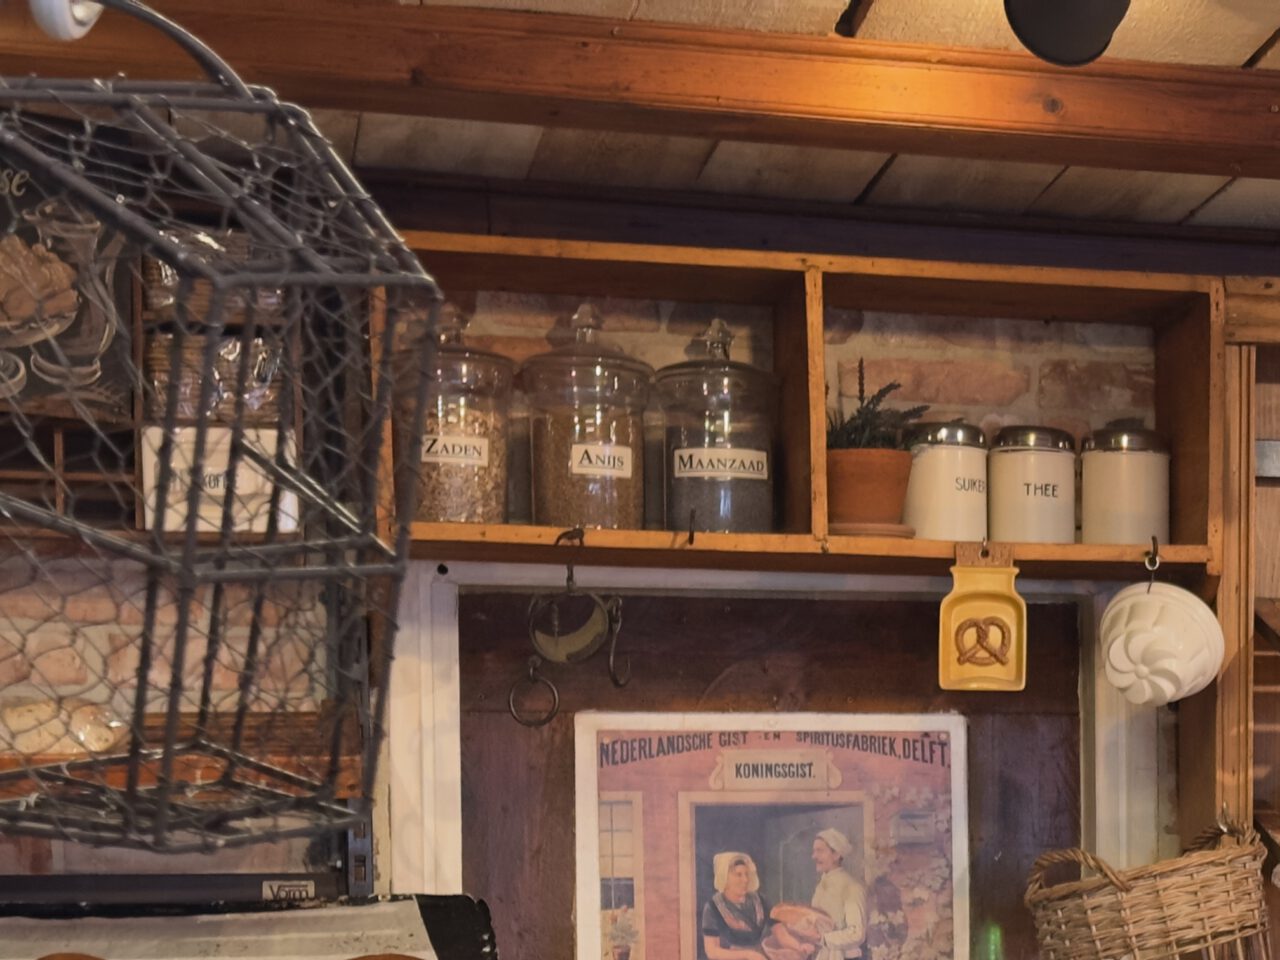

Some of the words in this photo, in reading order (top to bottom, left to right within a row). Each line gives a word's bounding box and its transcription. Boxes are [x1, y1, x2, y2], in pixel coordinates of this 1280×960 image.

[678, 453, 766, 473] MAANZAAD
[1023, 482, 1059, 499] THEE
[600, 732, 713, 768] NEDERLANDSCHE
[718, 731, 748, 747] GIST
